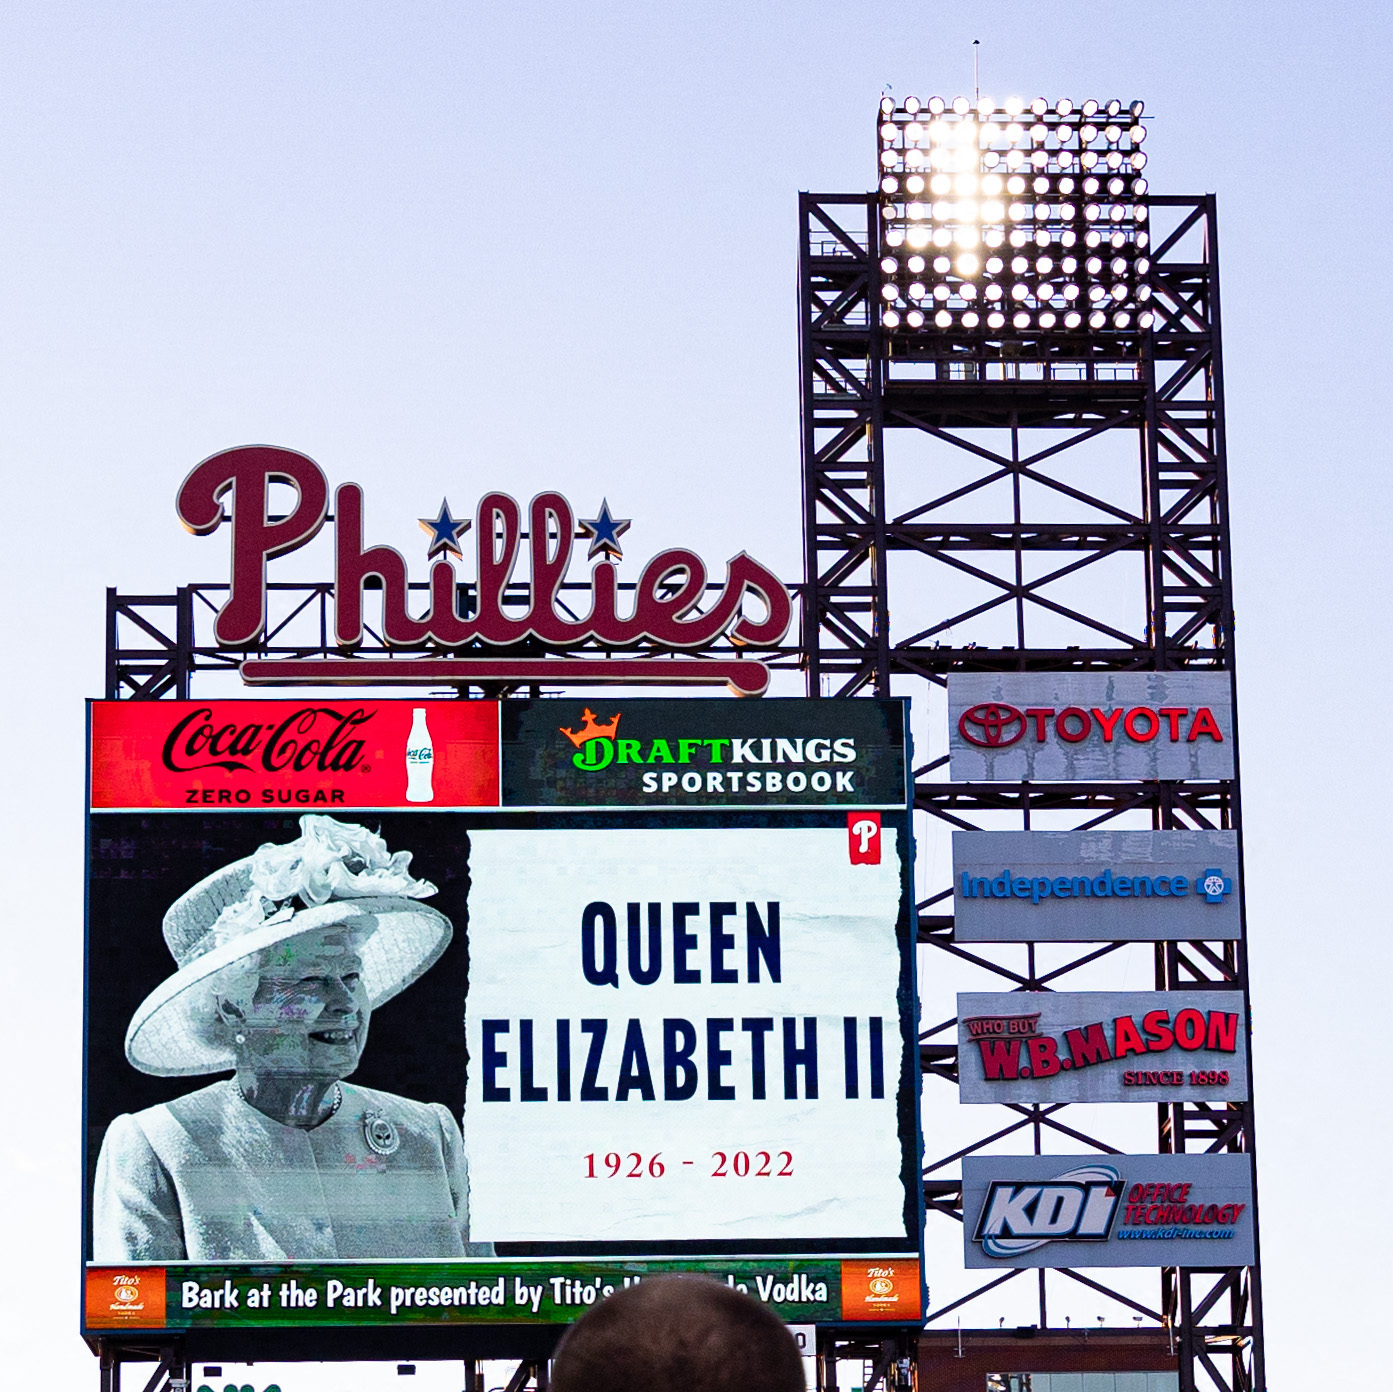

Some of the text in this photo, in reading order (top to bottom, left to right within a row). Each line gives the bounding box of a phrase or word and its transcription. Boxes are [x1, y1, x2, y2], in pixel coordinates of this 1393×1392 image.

[175, 443, 794, 648] Phillies
[161, 707, 379, 773] Coca-Cola
[1025, 706, 1224, 742] TOYOTA
[572, 736, 857, 772] DRAFTKINGS
[185, 789, 345, 804] ZERO SUGAR
[641, 770, 856, 793] SPORTSBOOK
[961, 868, 1190, 905] Independence
[581, 900, 782, 989] QUEEN
[968, 1017, 1038, 1036] WHO BUT
[480, 1016, 885, 1102] ELIZABETH II
[1123, 1069, 1230, 1086] SINCE 1898
[583, 1151, 666, 1179] 1926
[710, 1151, 795, 1178] 2022
[1127, 1182, 1193, 1204] OFFICE
[1122, 1203, 1246, 1226] TECHNOLOGY
[1117, 1227, 1234, 1240] www.kdi-inc.com
[181, 1280, 239, 1309] Bark
[246, 1283, 271, 1308] at
[279, 1280, 317, 1308] the
[326, 1279, 383, 1308] Park
[391, 1277, 505, 1315] presented
[514, 1276, 543, 1313] by
[549, 1276, 614, 1305] Tito's
[755, 1274, 828, 1303] Vodka
